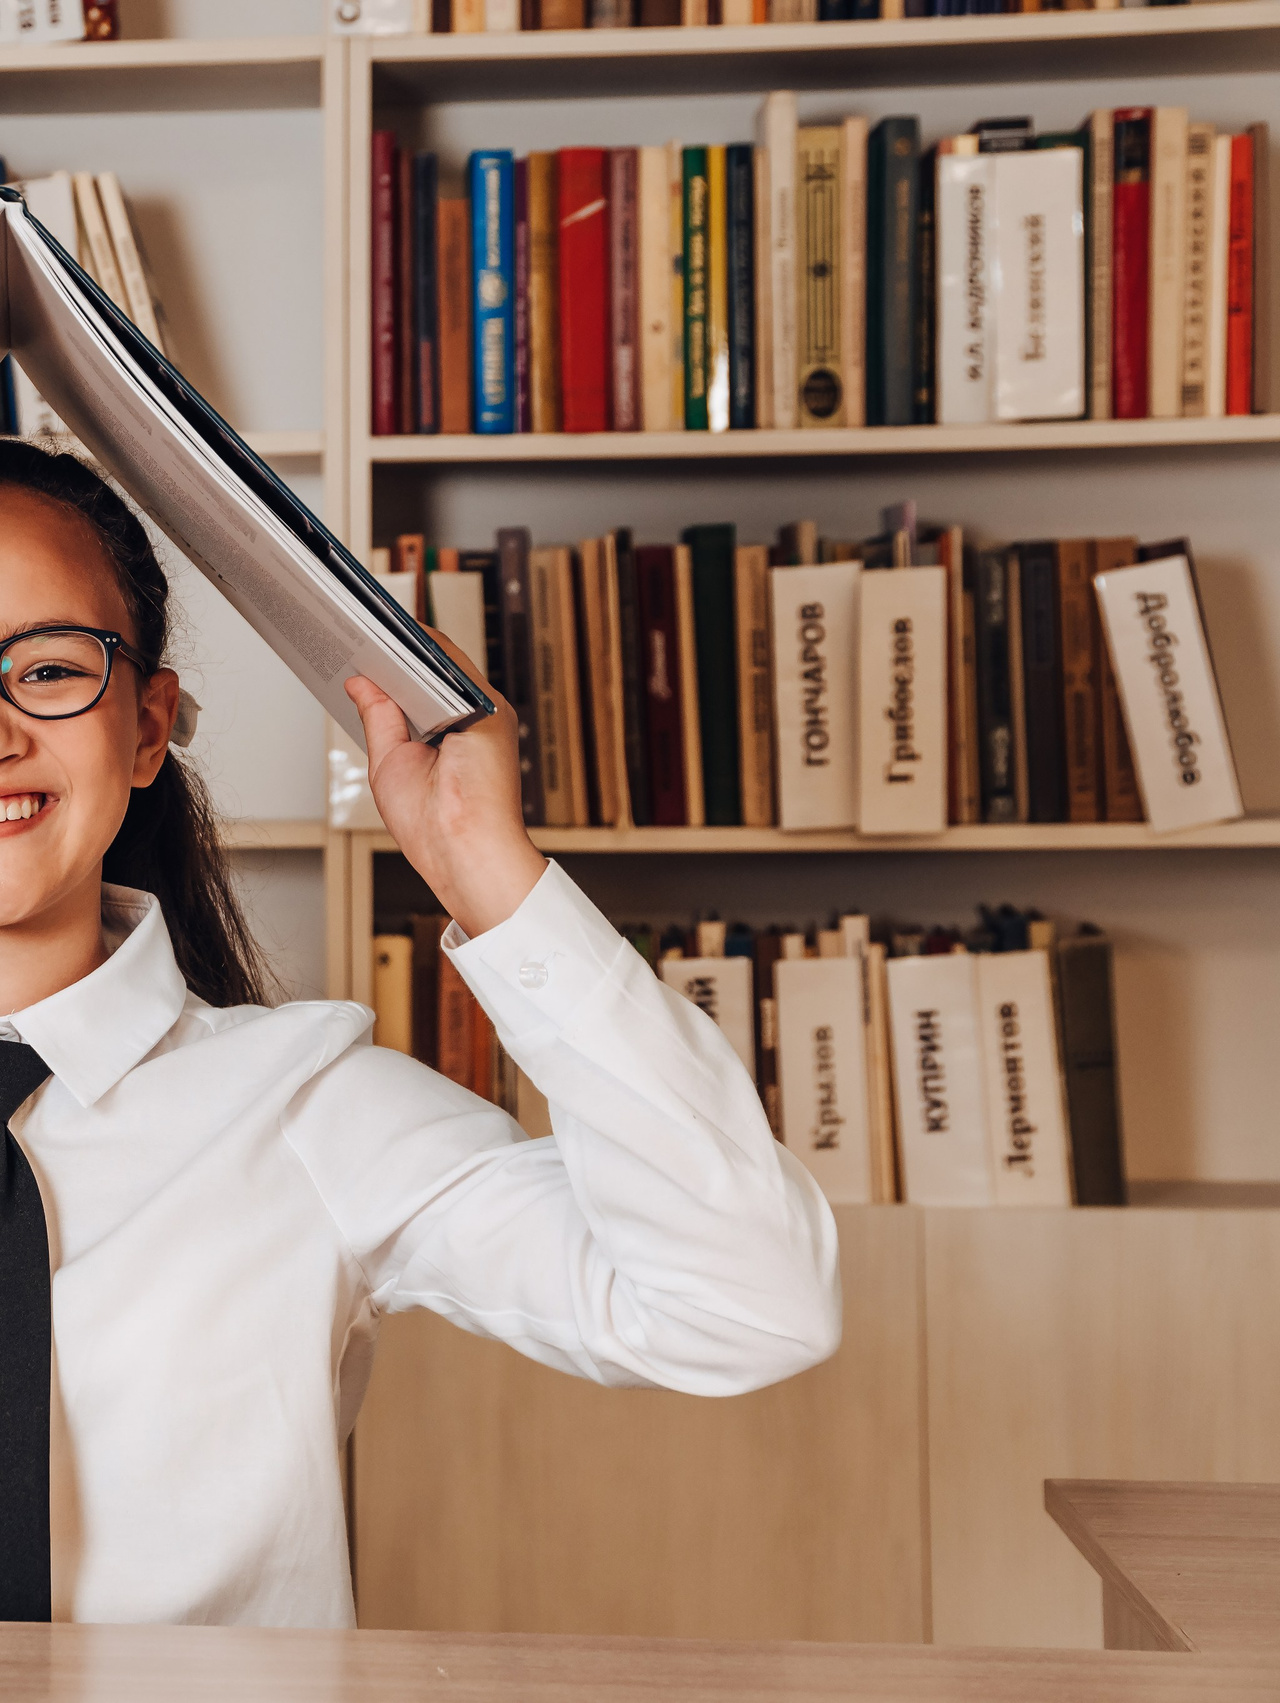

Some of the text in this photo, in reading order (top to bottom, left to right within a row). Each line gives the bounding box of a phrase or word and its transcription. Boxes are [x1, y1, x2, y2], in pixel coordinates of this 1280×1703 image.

[795, 600, 830, 768] ГОНЧАРОВ
[882, 617, 922, 786] Грибоедов
[1135, 591, 1201, 788] Добролюбов
[809, 1025, 846, 1151] Крылов
[912, 1008, 950, 1135] КУПРИН
[995, 1001, 1038, 1179] Лермонтов
